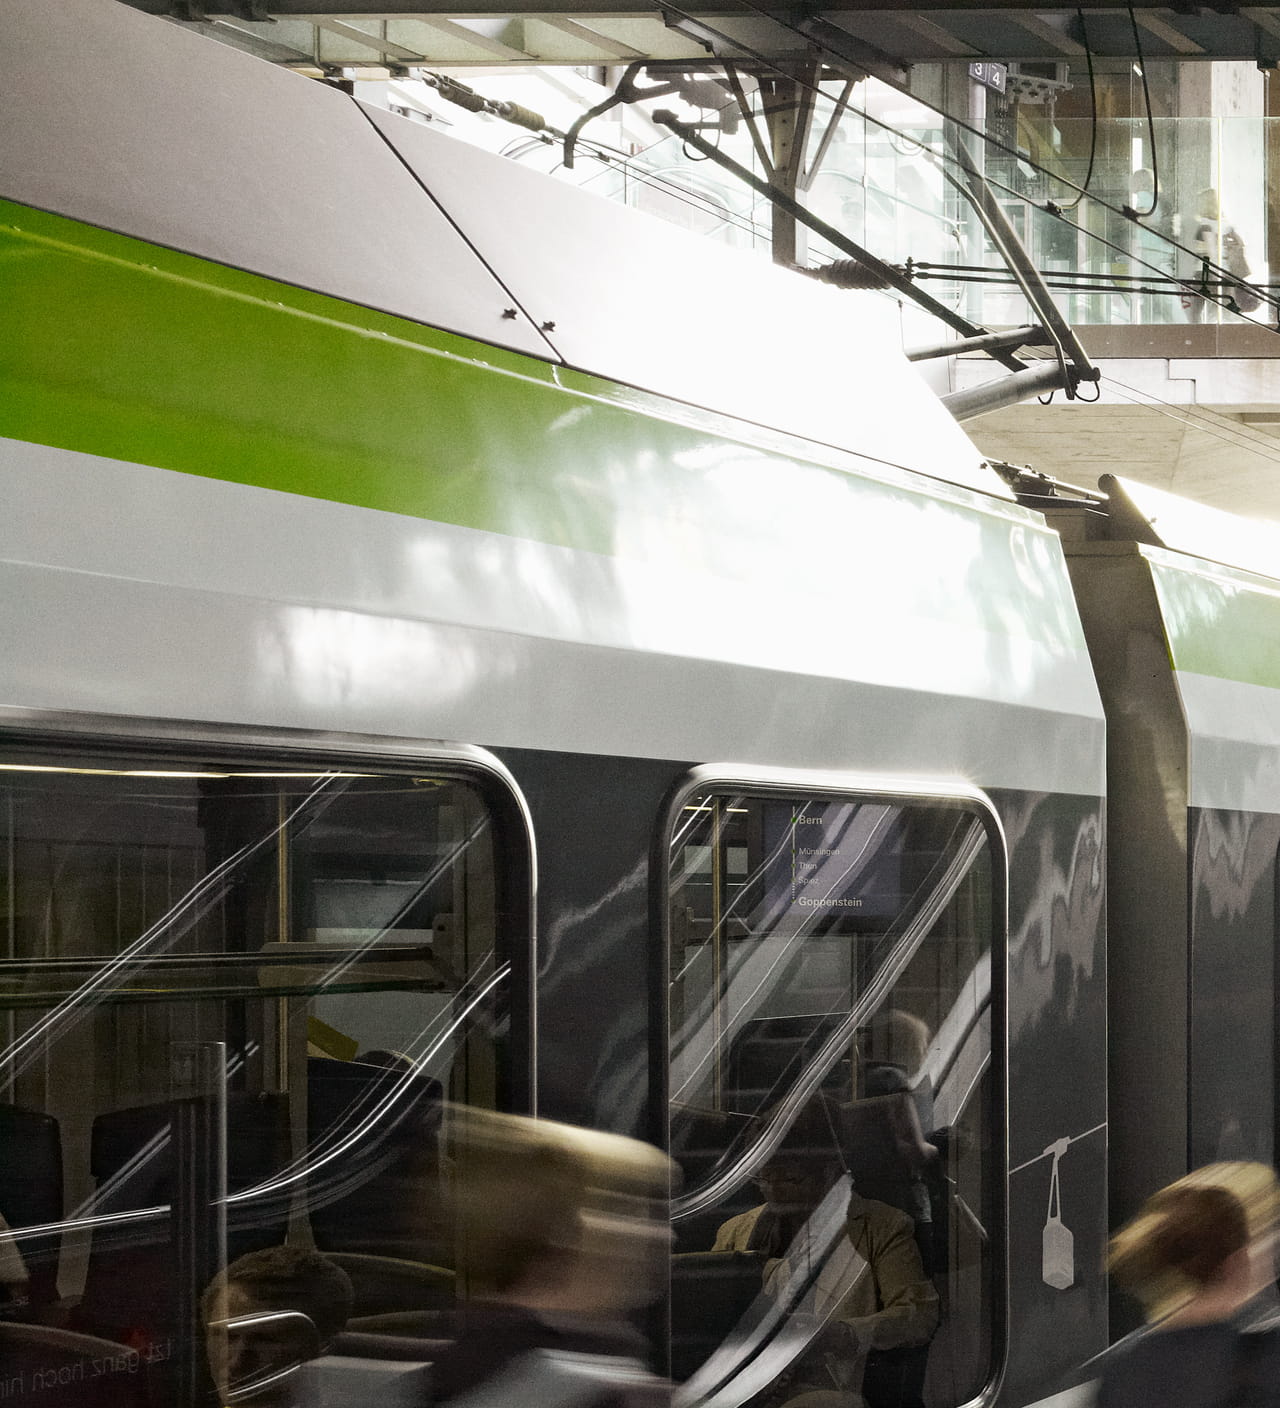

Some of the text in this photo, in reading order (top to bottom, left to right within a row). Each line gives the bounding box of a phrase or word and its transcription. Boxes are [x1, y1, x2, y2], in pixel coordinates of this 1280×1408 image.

[974, 62, 983, 76] 3
[992, 72, 1001, 86] 4
[799, 815, 823, 825] Bern
[799, 847, 841, 857] Münsingen
[799, 861, 817, 870] Thun
[799, 876, 819, 885] Spiez
[798, 896, 863, 909] Goppenstein
